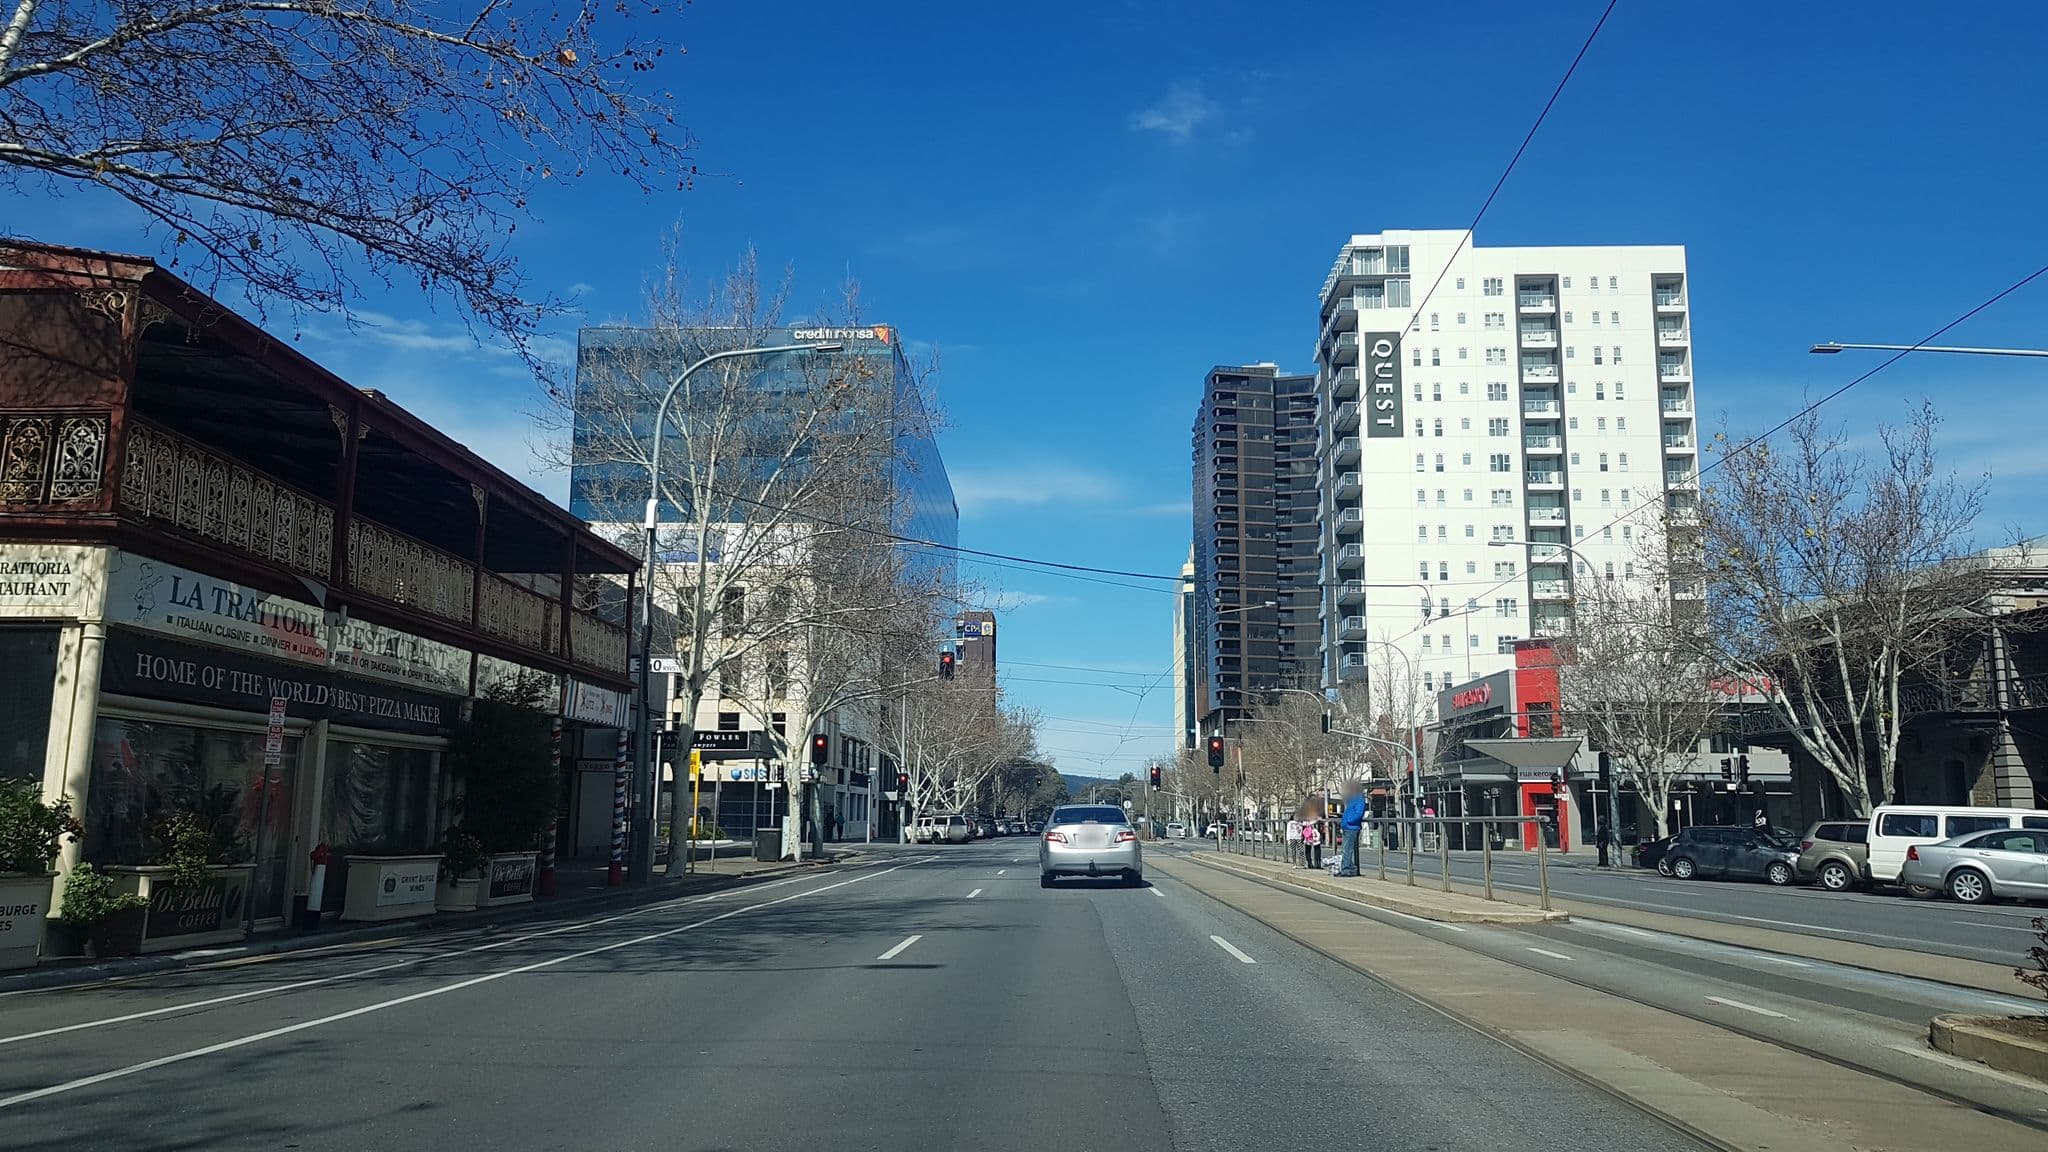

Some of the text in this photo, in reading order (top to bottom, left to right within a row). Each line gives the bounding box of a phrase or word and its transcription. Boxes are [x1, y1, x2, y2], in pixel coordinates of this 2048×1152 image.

[1370, 339, 1395, 428] QUEST
[168, 575, 449, 672] LA TRATTORIA RESTAURANT
[176, 614, 213, 635] ITALIAN
[214, 624, 251, 644] CUISINE
[260, 634, 292, 652] DINNER
[299, 643, 325, 660] LUNCH
[370, 659, 402, 677] TAKEAWAY
[136, 652, 197, 686] HOME
[202, 665, 226, 690] OF
[229, 669, 264, 696] THE
[338, 688, 367, 713] BEST
[369, 696, 401, 719] PIZZA
[404, 702, 441, 725] MAKER
[177, 912, 217, 929] COFFEE
[181, 885, 222, 912] Bella
